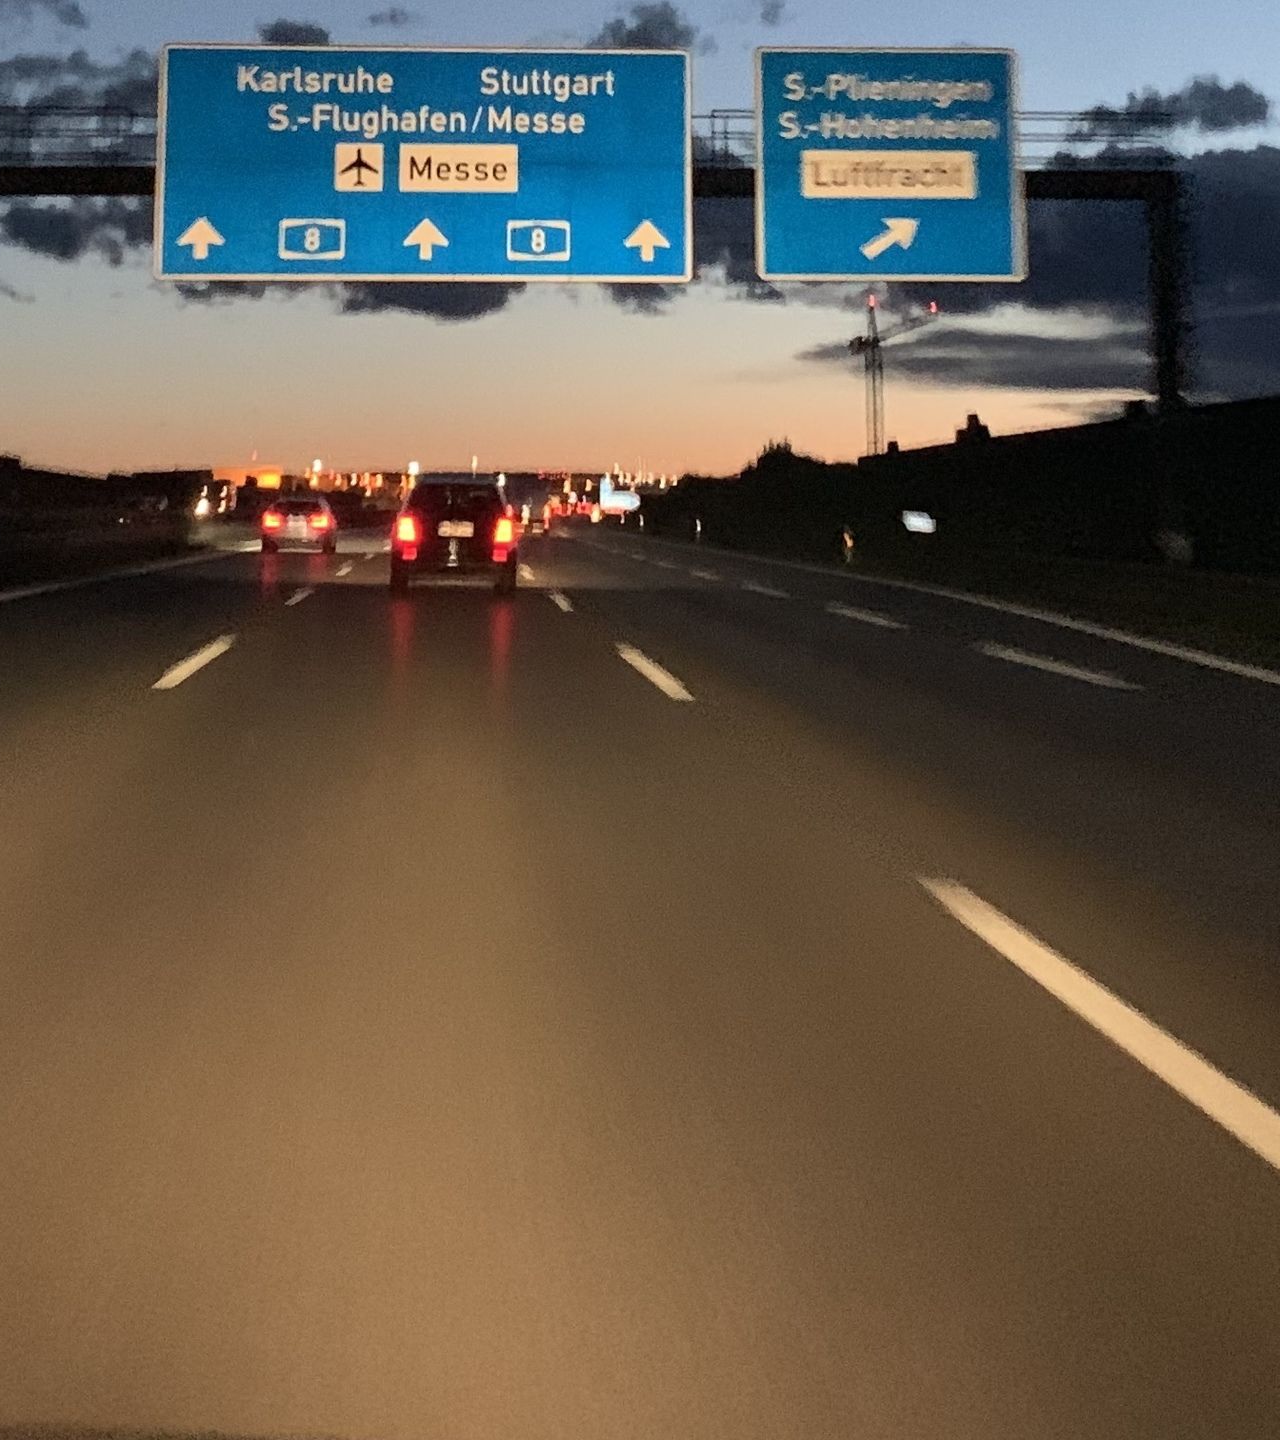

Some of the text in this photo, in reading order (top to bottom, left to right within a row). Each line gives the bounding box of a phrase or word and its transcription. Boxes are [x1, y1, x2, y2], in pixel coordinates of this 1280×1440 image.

[236, 60, 394, 93] Karlsruhe
[480, 66, 615, 102] Stuttgart
[409, 155, 508, 181] Messe
[304, 227, 320, 252] 8
[531, 228, 546, 253] 8
